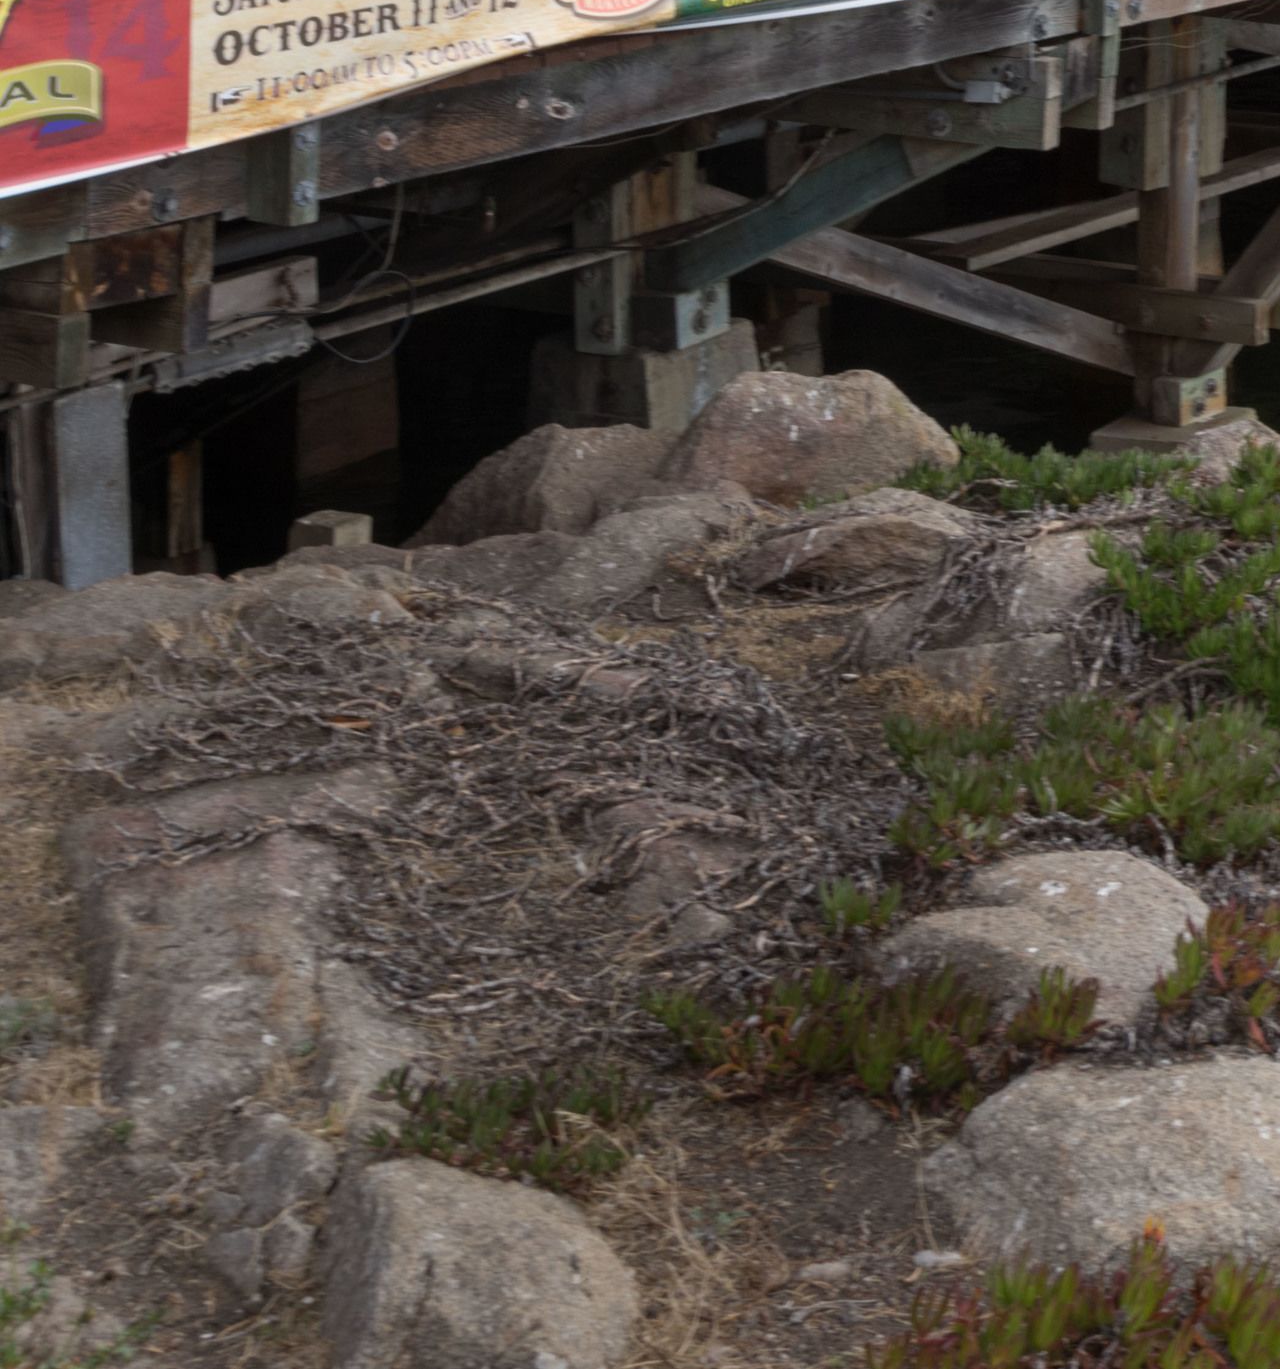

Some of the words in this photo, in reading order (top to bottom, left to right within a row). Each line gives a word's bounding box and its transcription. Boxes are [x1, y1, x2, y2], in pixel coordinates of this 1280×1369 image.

[212, 3, 402, 67] OCTOBER
[363, 53, 396, 79] TO
[0, 75, 76, 109] AL
